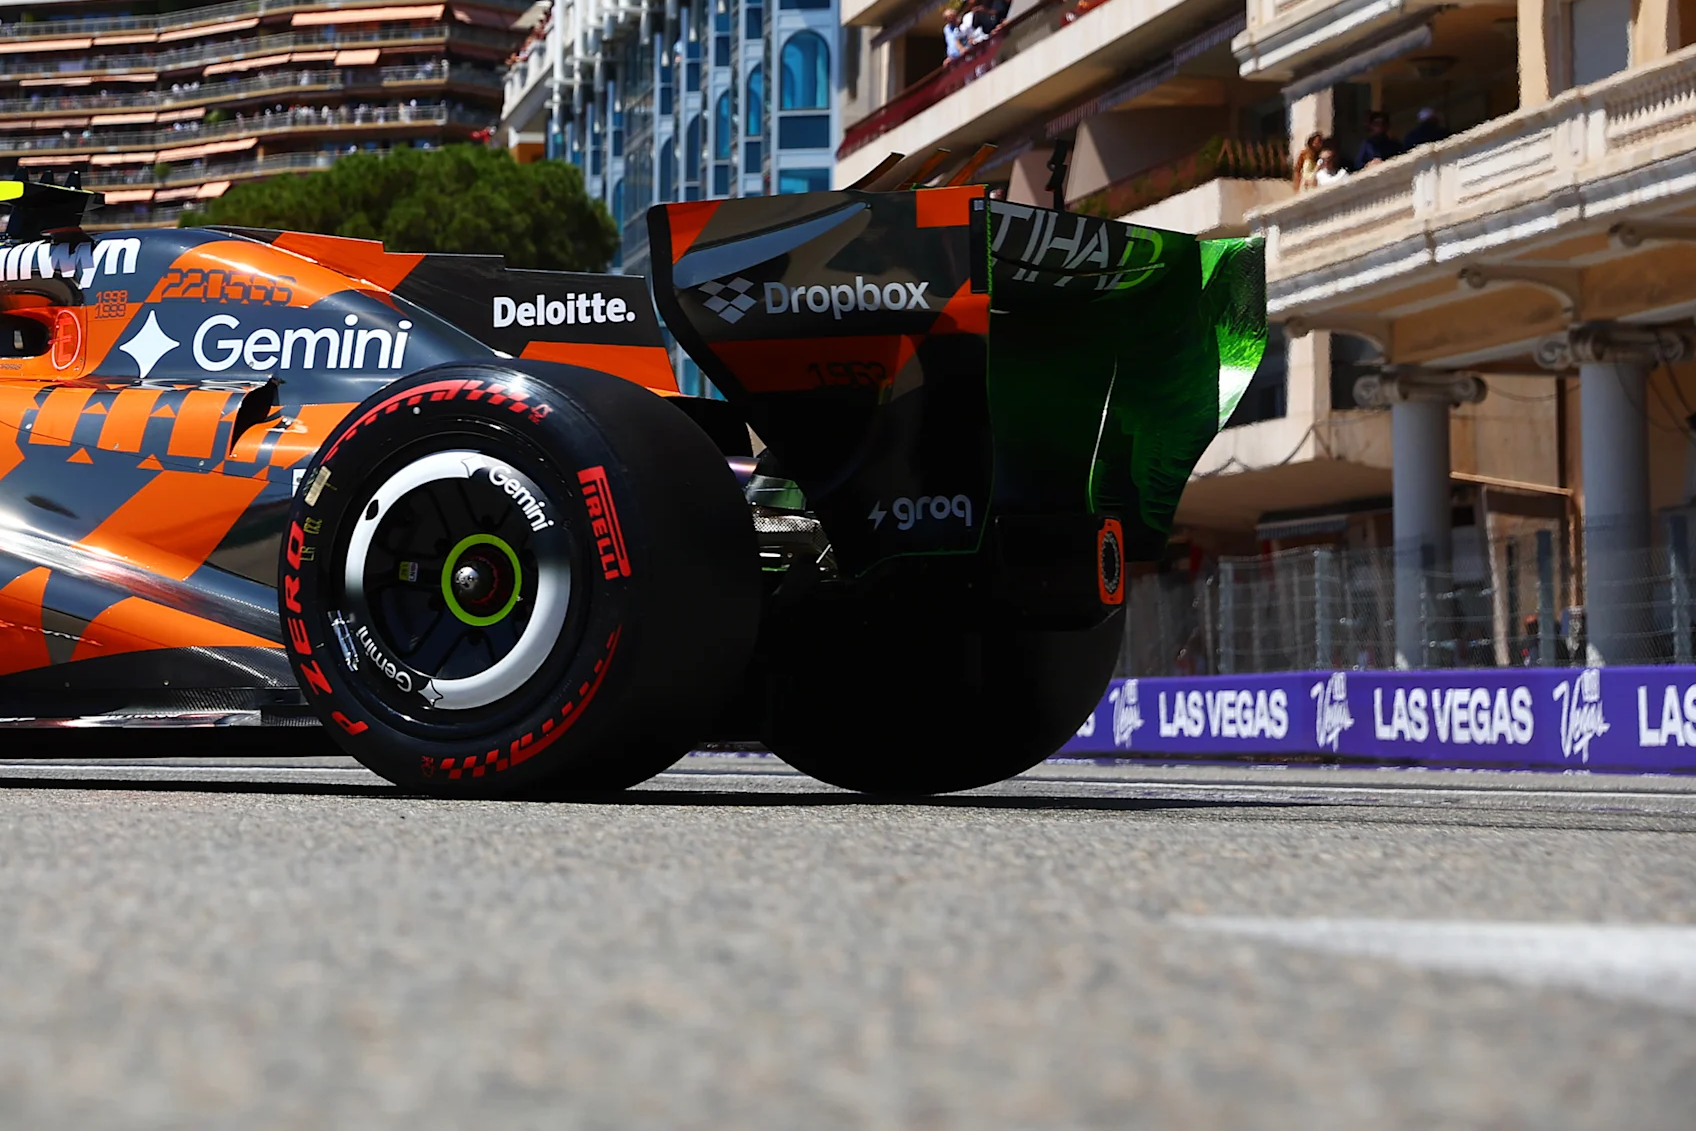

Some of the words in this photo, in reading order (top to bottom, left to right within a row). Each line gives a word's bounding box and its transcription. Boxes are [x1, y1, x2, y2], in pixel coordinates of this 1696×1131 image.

[492, 293, 636, 328] Deloitte.
[763, 275, 931, 321] Dropbox
[192, 314, 411, 372] Gemini
[488, 468, 554, 532] Gemini
[577, 465, 631, 581] PIRELLI
[891, 494, 973, 530] groq
[284, 521, 333, 696] ZERO
[357, 625, 413, 694] Gemini
[331, 710, 369, 736] P
[1159, 691, 1205, 738] LAS
[1205, 689, 1290, 740] VEGAS
[1373, 687, 1428, 743] LAS
[1431, 686, 1535, 745] VEGAS
